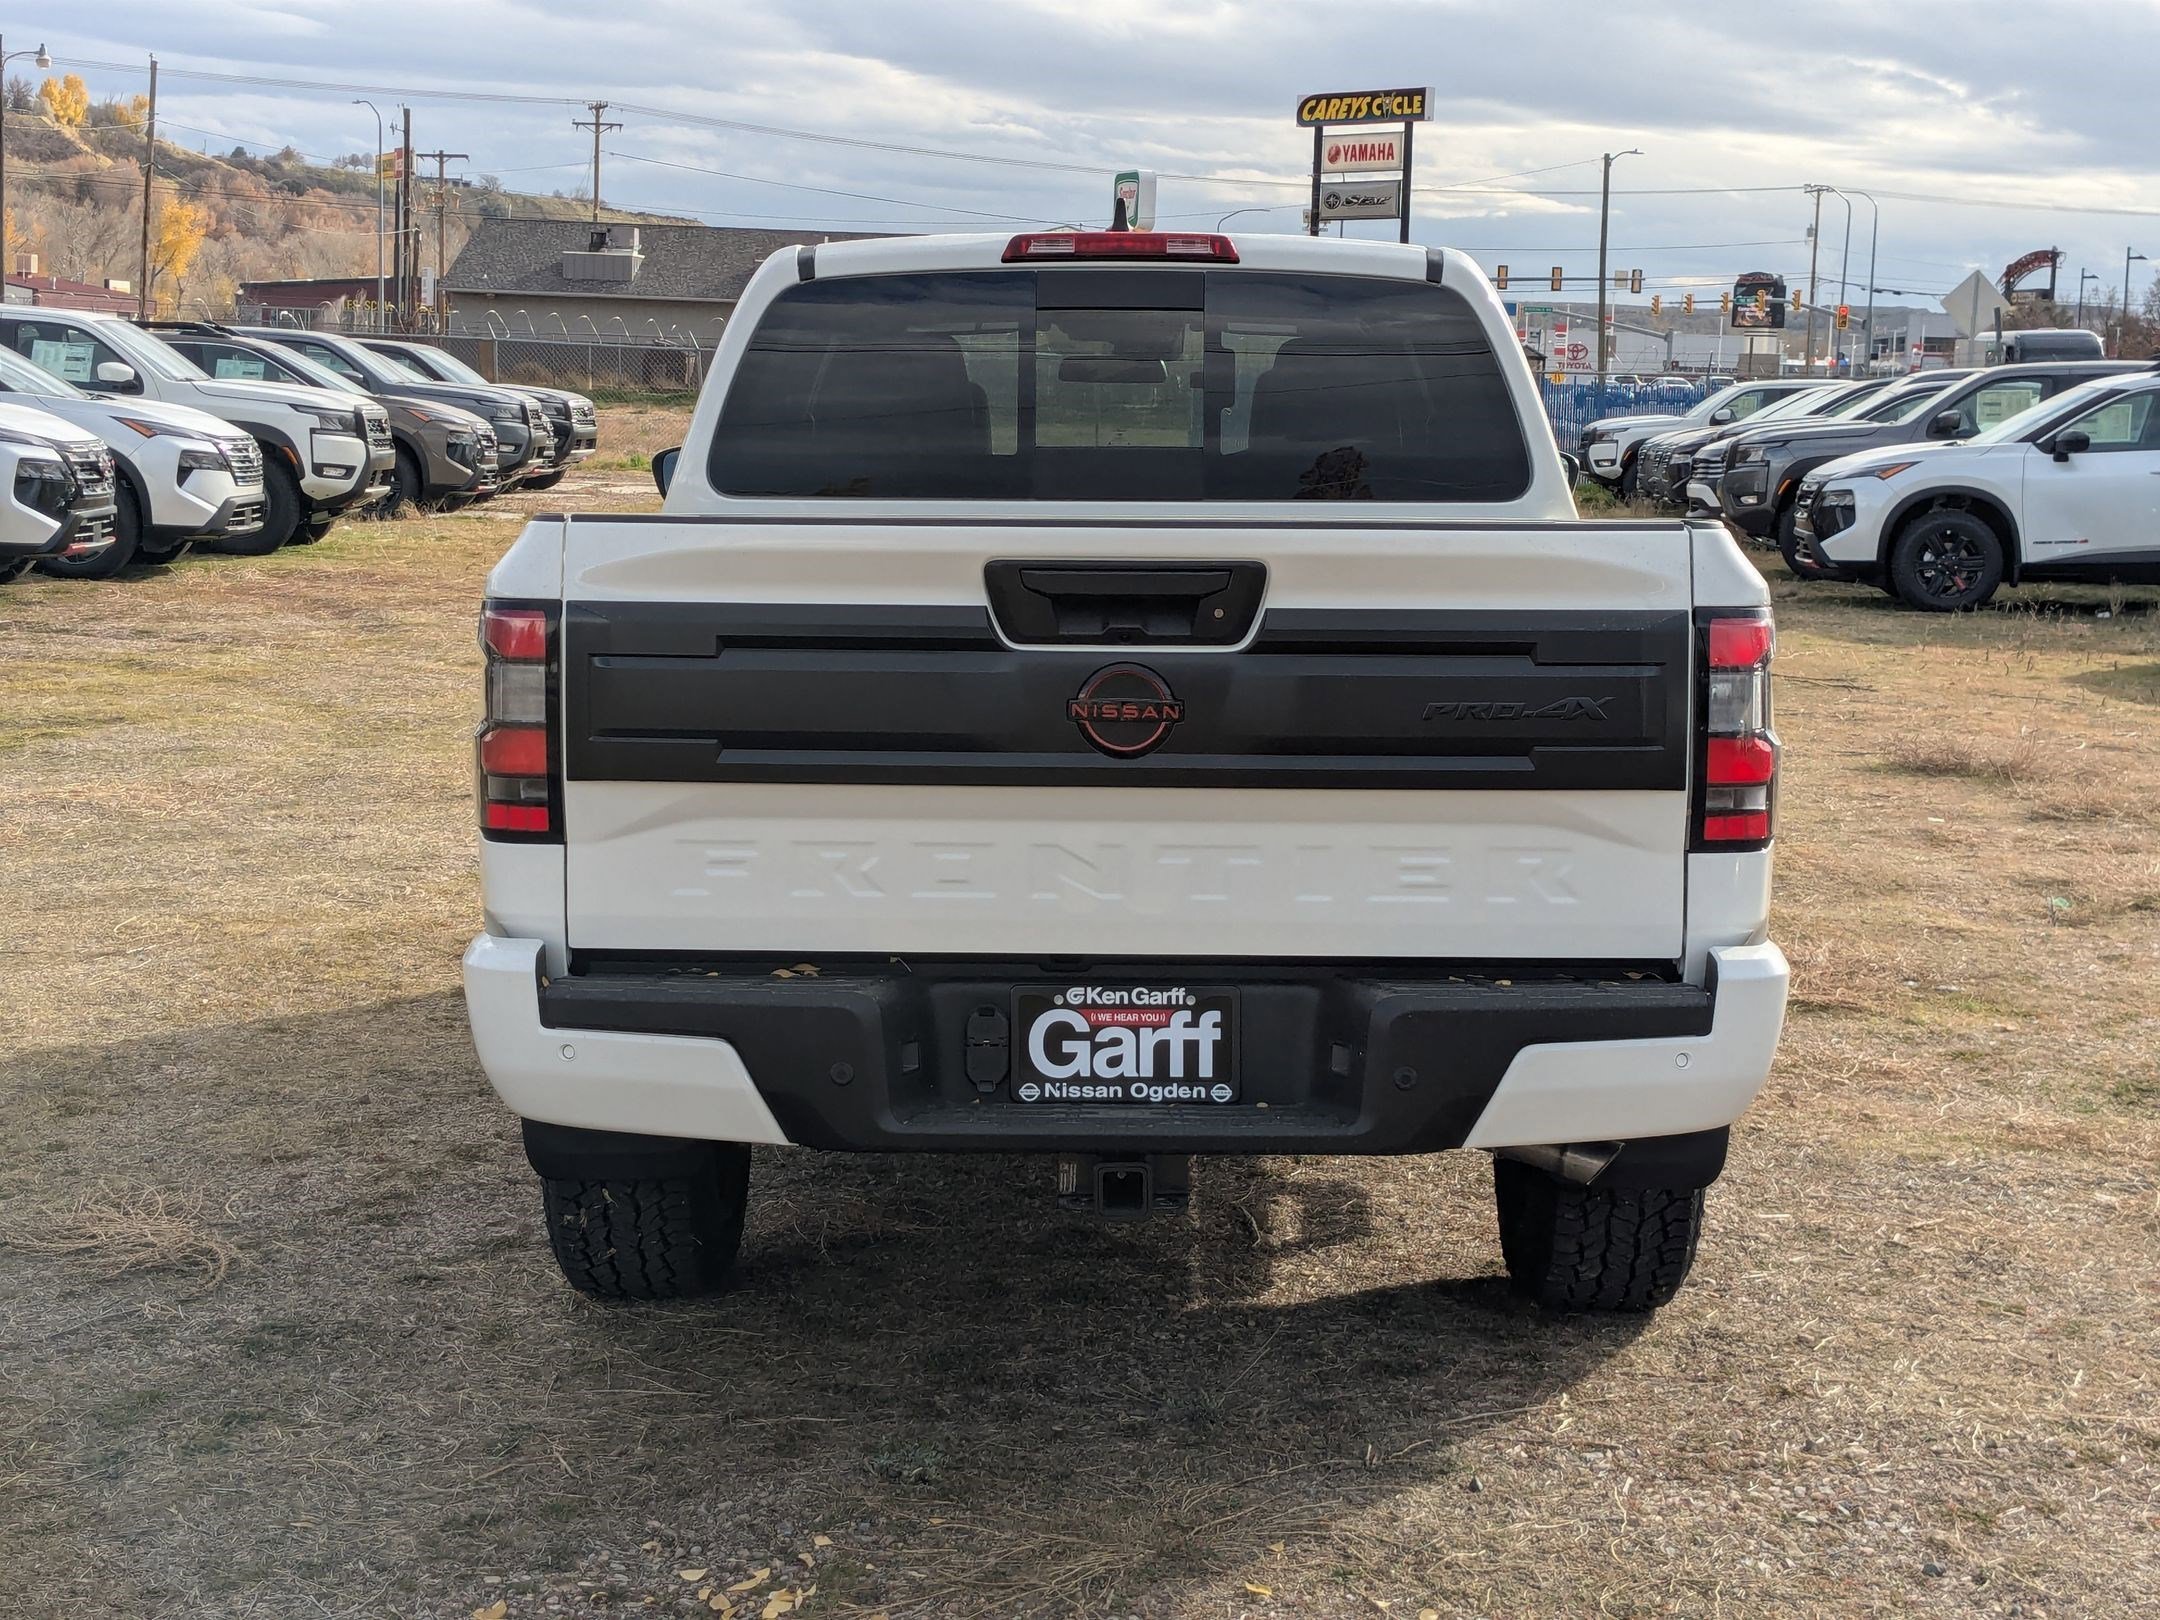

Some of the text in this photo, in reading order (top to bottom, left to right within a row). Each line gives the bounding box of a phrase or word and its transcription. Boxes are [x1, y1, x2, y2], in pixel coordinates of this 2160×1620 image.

[1302, 95, 1372, 121] CAREYS
[1342, 142, 1395, 162] YAMAHA
[1071, 703, 1180, 719] NISSAN
[671, 839, 1578, 904] FRONTIER
[1087, 987, 1186, 1005] Ken Garff
[1098, 1013, 1160, 1022] WE HEAR YOU
[1028, 1008, 1221, 1078] Garff
[1044, 1083, 1205, 1101] Nissan Ogden
